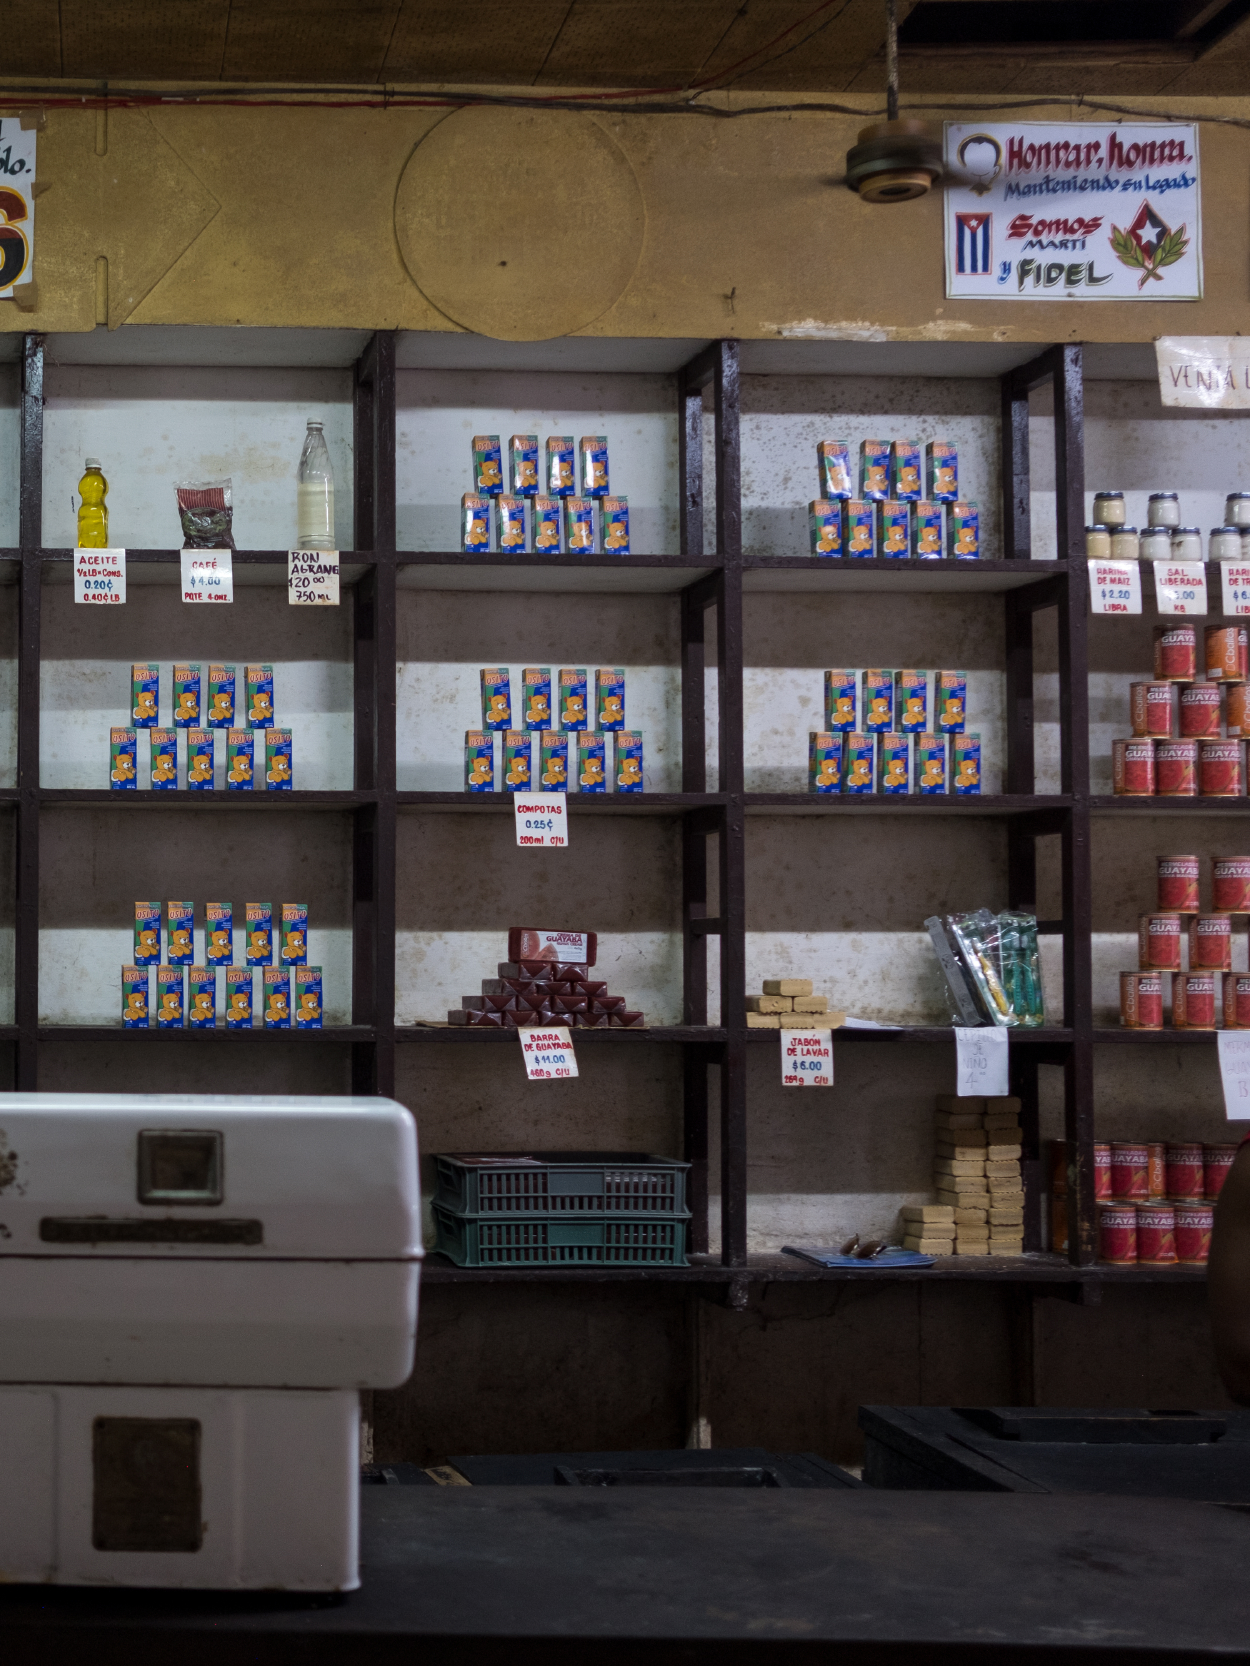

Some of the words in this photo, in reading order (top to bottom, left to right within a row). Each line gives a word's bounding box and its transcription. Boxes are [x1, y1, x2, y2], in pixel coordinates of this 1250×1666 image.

[1006, 135, 1105, 177] Honrar,
[1004, 173, 1119, 201] Manteniendo
[1119, 177, 1144, 193] su
[1006, 213, 1105, 240] Somos
[1016, 258, 1114, 292] FIDEL
[79, 555, 118, 565] ACEITE
[291, 552, 320, 563] RON
[192, 557, 218, 570] CAFÉ
[1096, 567, 1129, 576] HARINA
[1167, 568, 1189, 577] SAL
[84, 579, 114, 593] 0.20¢
[1097, 576, 1108, 585] DE
[1160, 577, 1204, 587] LIBERADA
[1228, 577, 1240, 586] DE
[296, 590, 317, 602] 750
[1103, 603, 1129, 612] LIBRA
[517, 804, 563, 814] COMPOTAS
[525, 818, 553, 831] 0.25¢
[530, 1034, 561, 1042] BARRA
[790, 1034, 822, 1047] JABÓN
[523, 1043, 535, 1052] DE
[535, 1042, 573, 1052] GUAYABA
[786, 1047, 798, 1057] DE
[801, 1047, 830, 1058] LAVAR
[792, 1060, 823, 1072] $6.00
